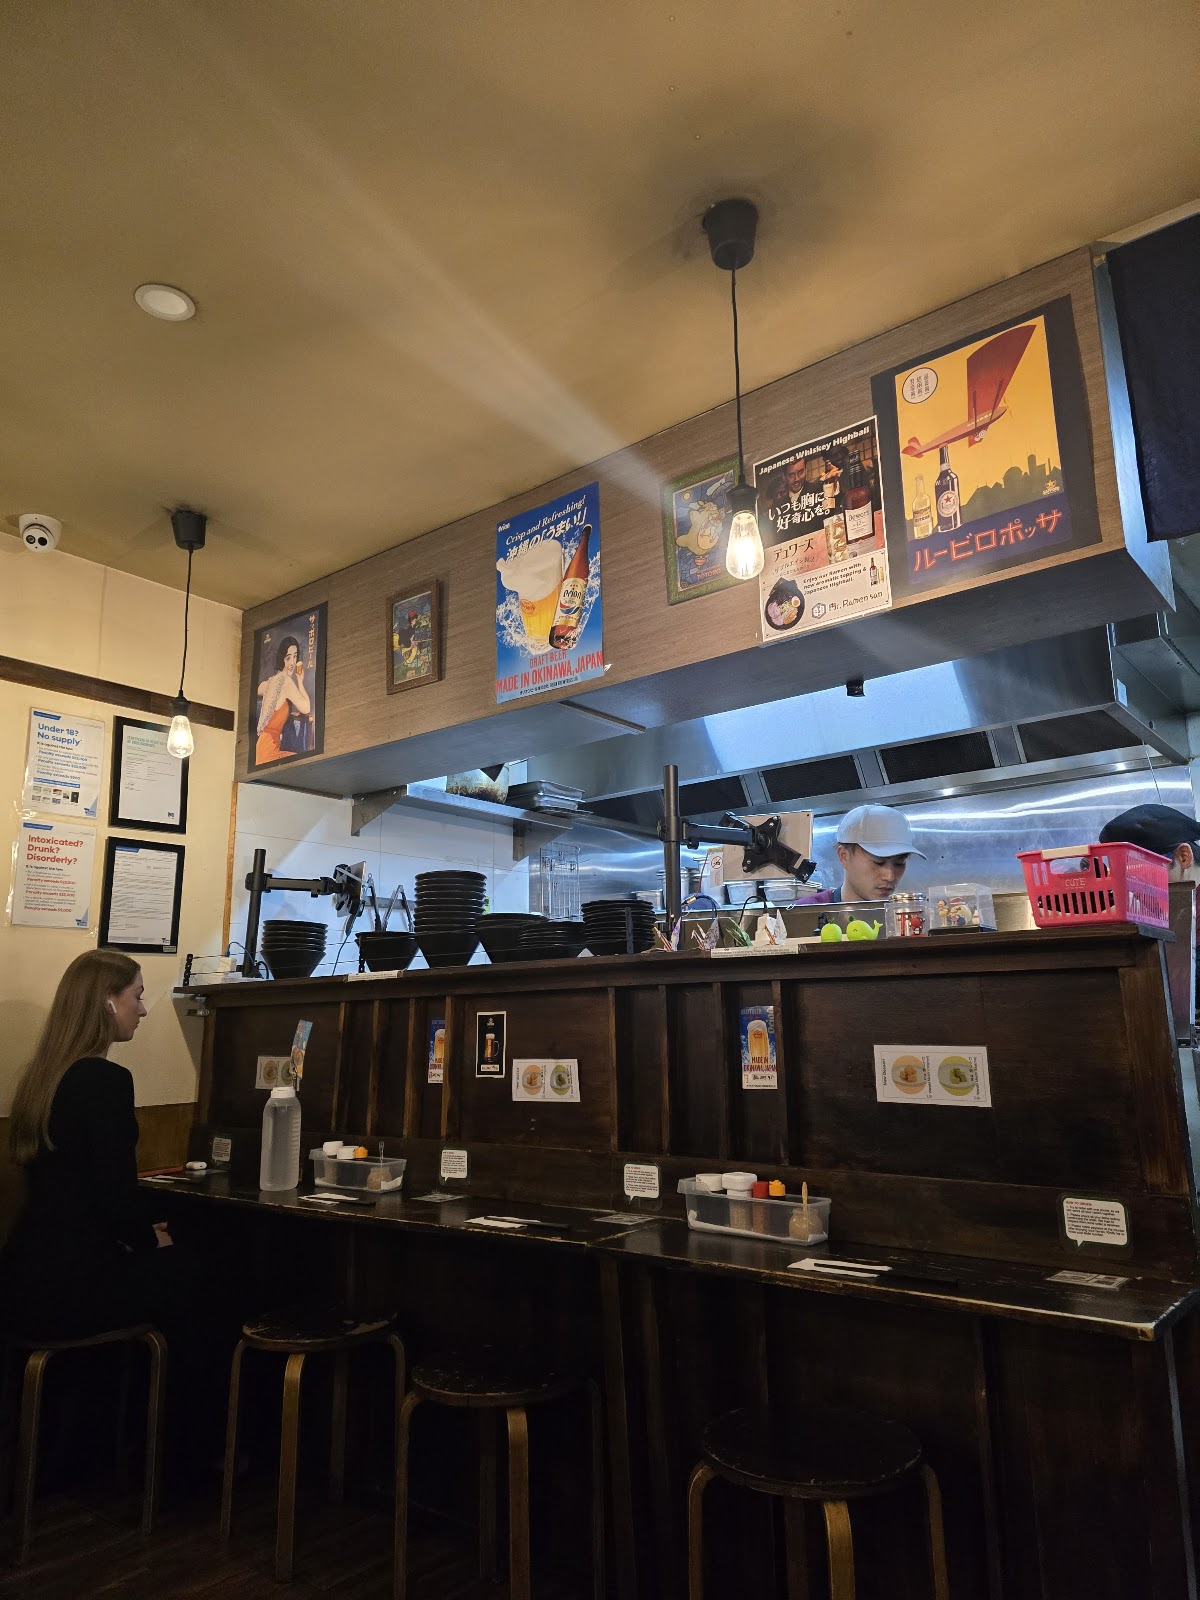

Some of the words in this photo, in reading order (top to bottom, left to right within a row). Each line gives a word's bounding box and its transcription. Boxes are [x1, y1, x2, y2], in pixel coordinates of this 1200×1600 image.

[759, 456, 795, 475] Japanese
[795, 442, 831, 460] Whiskey
[832, 426, 869, 446] Highball
[506, 531, 526, 545] Crisp
[526, 521, 541, 535] and
[849, 562, 862, 570] with
[816, 576, 839, 587] aromatic
[840, 569, 862, 580] topping
[870, 591, 883, 600] san
[530, 654, 549, 668] DRAFT
[550, 650, 567, 662] BEER
[496, 674, 518, 694] MADE
[521, 672, 530, 688] IN
[532, 661, 574, 685] OKINAWA,
[575, 650, 604, 673] JAPAN
[38, 723, 64, 733] Under
[66, 728, 79, 736] 18?
[52, 736, 80, 746] supply
[28, 835, 83, 847] Intoxicated?
[27, 844, 60, 853] Drunk?
[26, 853, 77, 865] Disorderly?
[1065, 878, 1085, 886] CUTE
